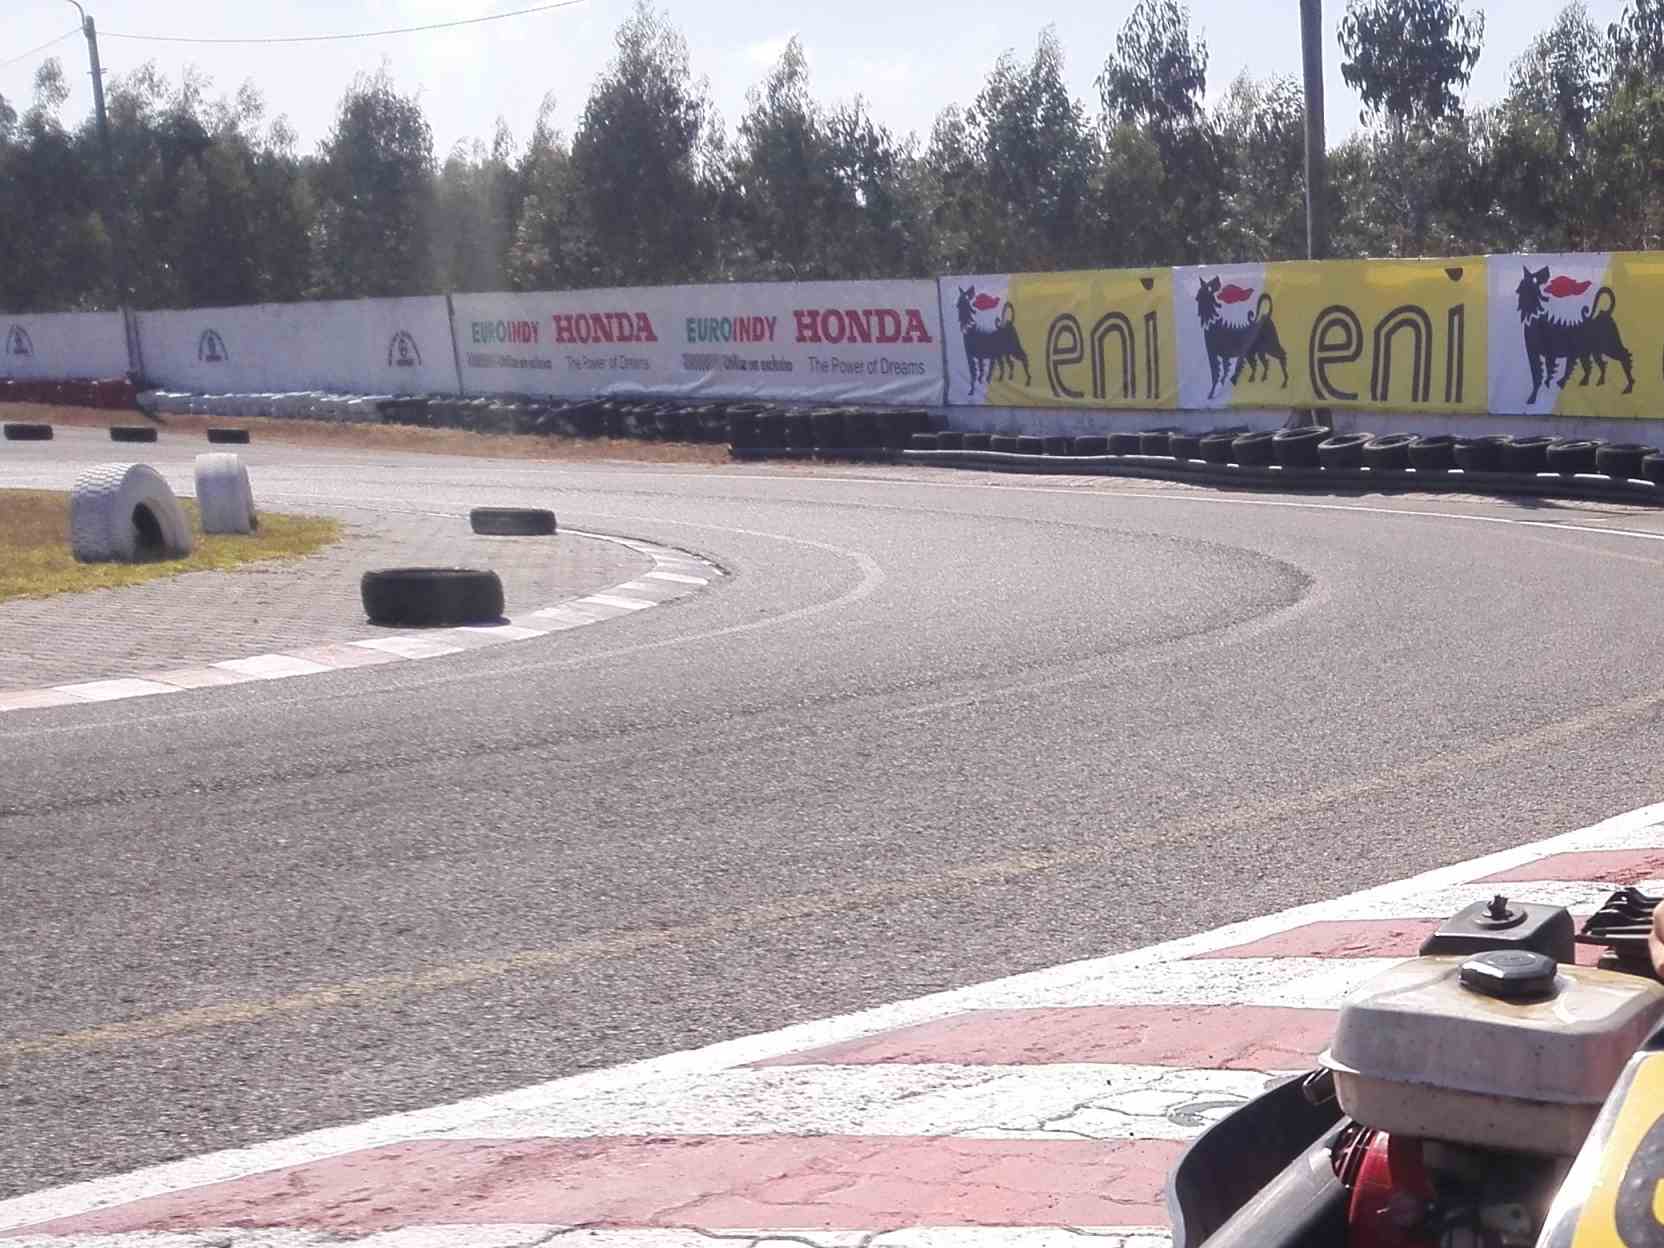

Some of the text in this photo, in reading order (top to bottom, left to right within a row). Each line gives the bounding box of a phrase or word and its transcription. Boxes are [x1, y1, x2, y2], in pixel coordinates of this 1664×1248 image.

[472, 312, 658, 344] EUROINDY HONDA
[686, 308, 933, 344] EUROINDY HONDA
[1046, 278, 1160, 399] eni
[1310, 267, 1464, 403] eni
[808, 356, 829, 373] The
[831, 357, 864, 375] Power
[866, 357, 880, 375] of
[881, 357, 926, 376] Dreams
